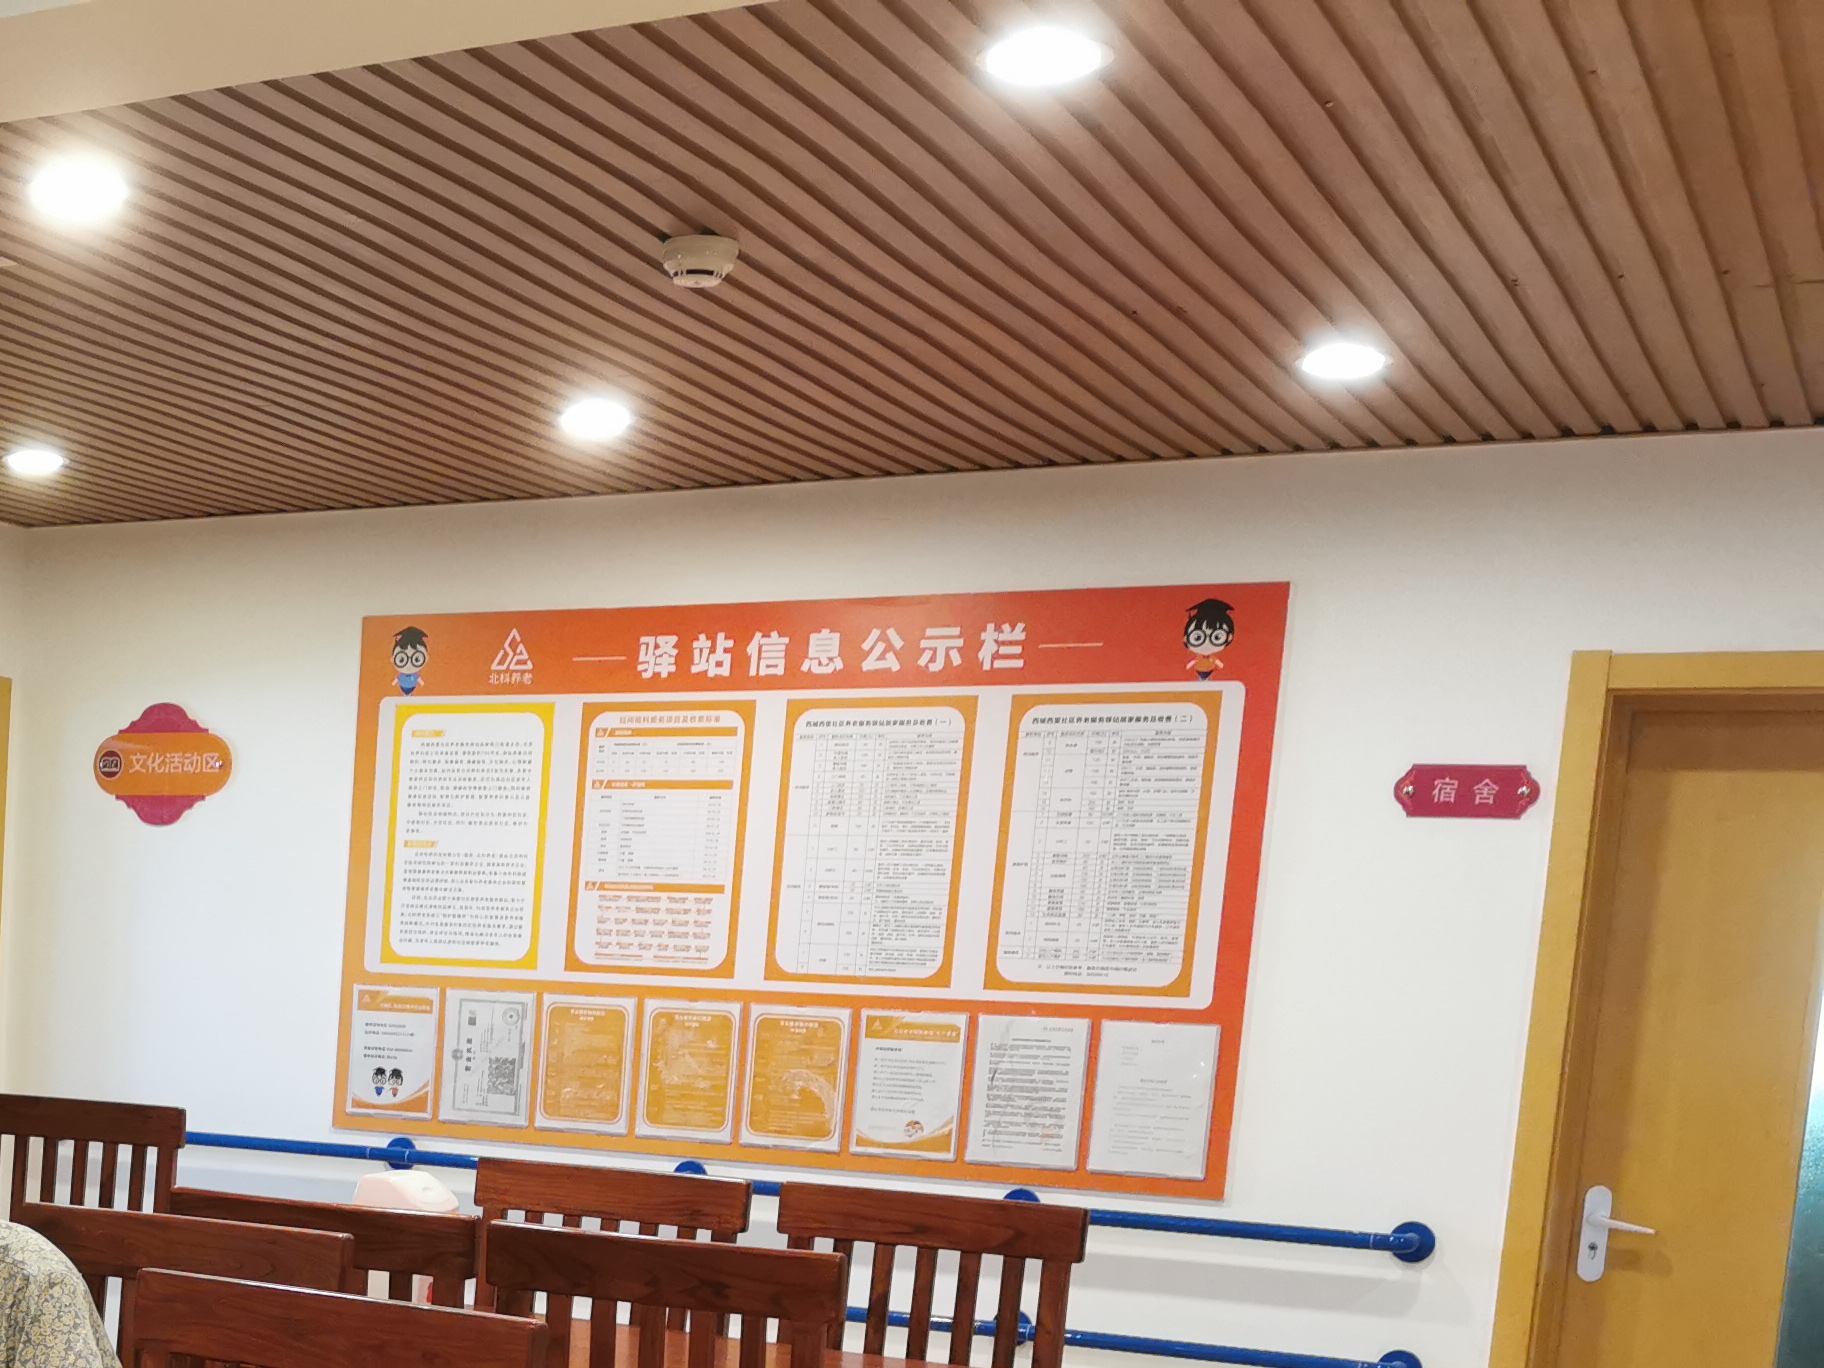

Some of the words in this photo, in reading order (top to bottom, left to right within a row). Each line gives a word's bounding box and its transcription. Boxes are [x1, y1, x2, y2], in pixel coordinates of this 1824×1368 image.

[636, 622, 1028, 679] 驿站信息公示栏
[487, 671, 534, 686] 北科养老
[128, 752, 220, 774] 文化活动区
[1431, 776, 1500, 805] 宿舍
